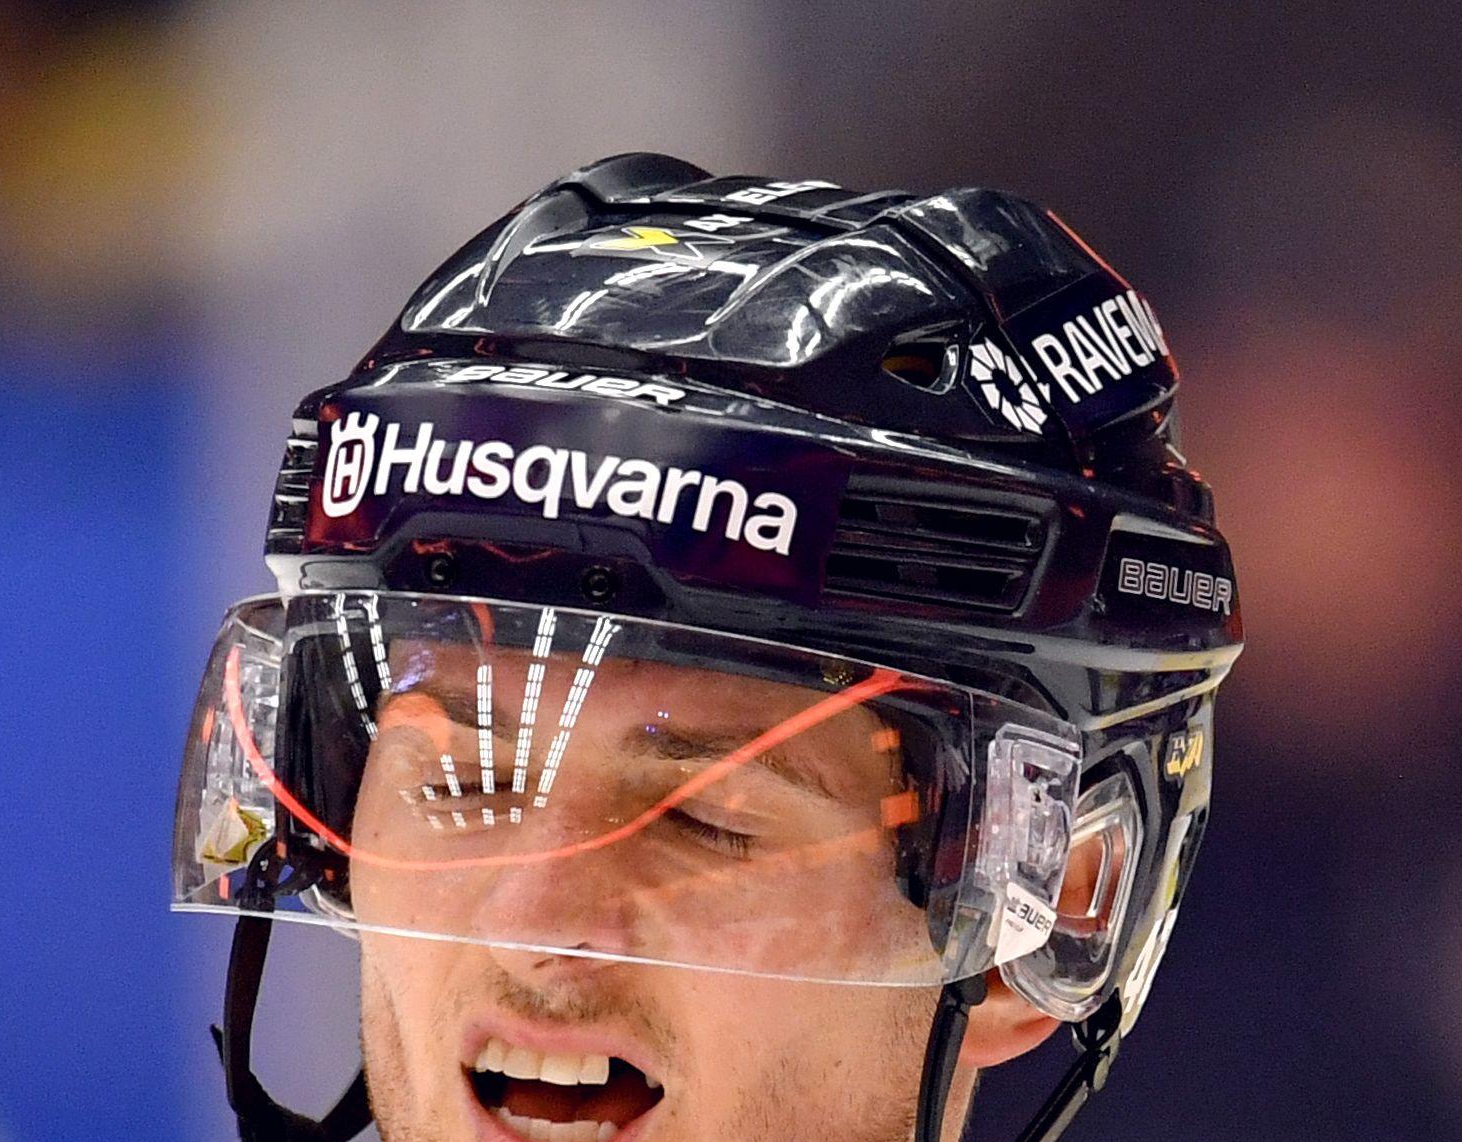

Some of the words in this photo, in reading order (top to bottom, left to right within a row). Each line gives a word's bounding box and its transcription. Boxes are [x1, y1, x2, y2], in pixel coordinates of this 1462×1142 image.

[445, 365, 686, 406] BAUER
[1032, 289, 1169, 404] RAVEM
[374, 421, 798, 556] Husqvarna
[1118, 557, 1232, 616] BAUER
